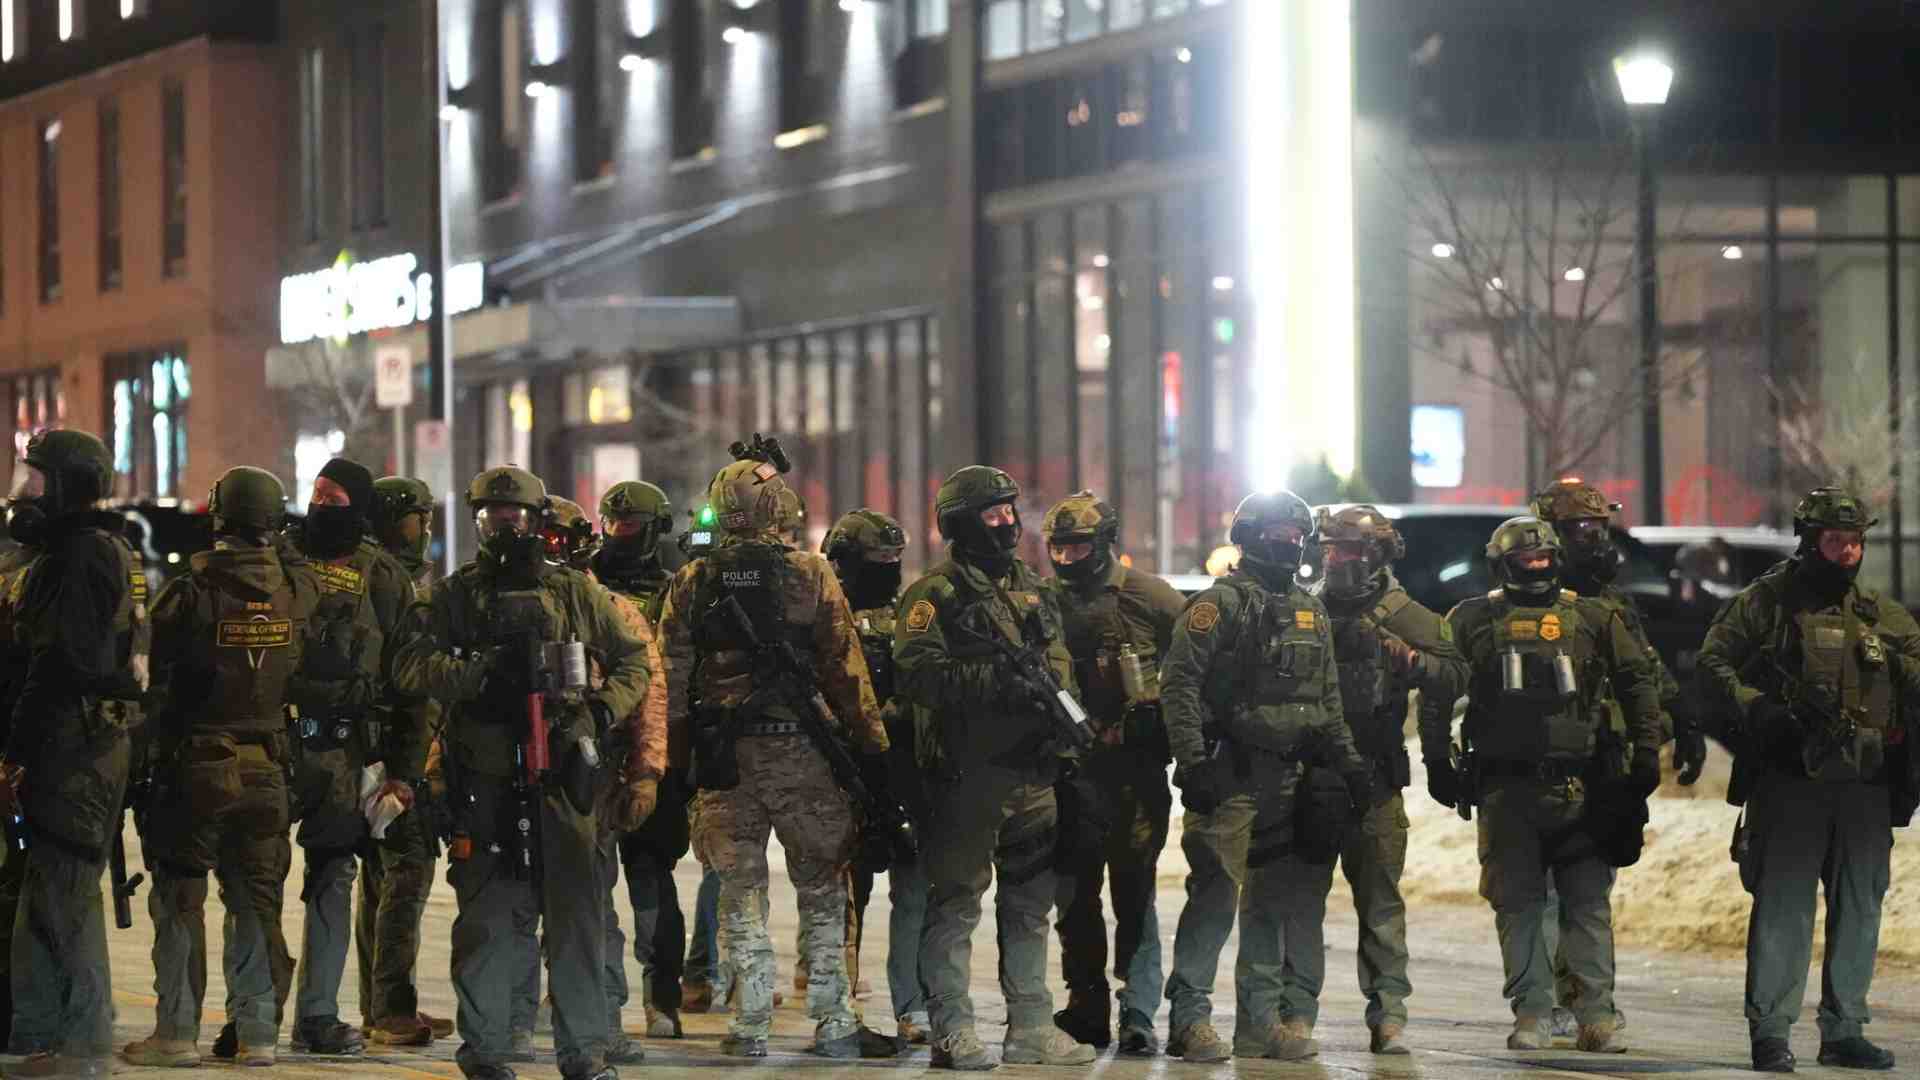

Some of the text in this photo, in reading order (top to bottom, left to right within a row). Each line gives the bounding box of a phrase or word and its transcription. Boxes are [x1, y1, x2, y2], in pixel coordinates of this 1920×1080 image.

[722, 570, 761, 581] POLICE
[223, 623, 289, 634] FEDERAL OFFICER
